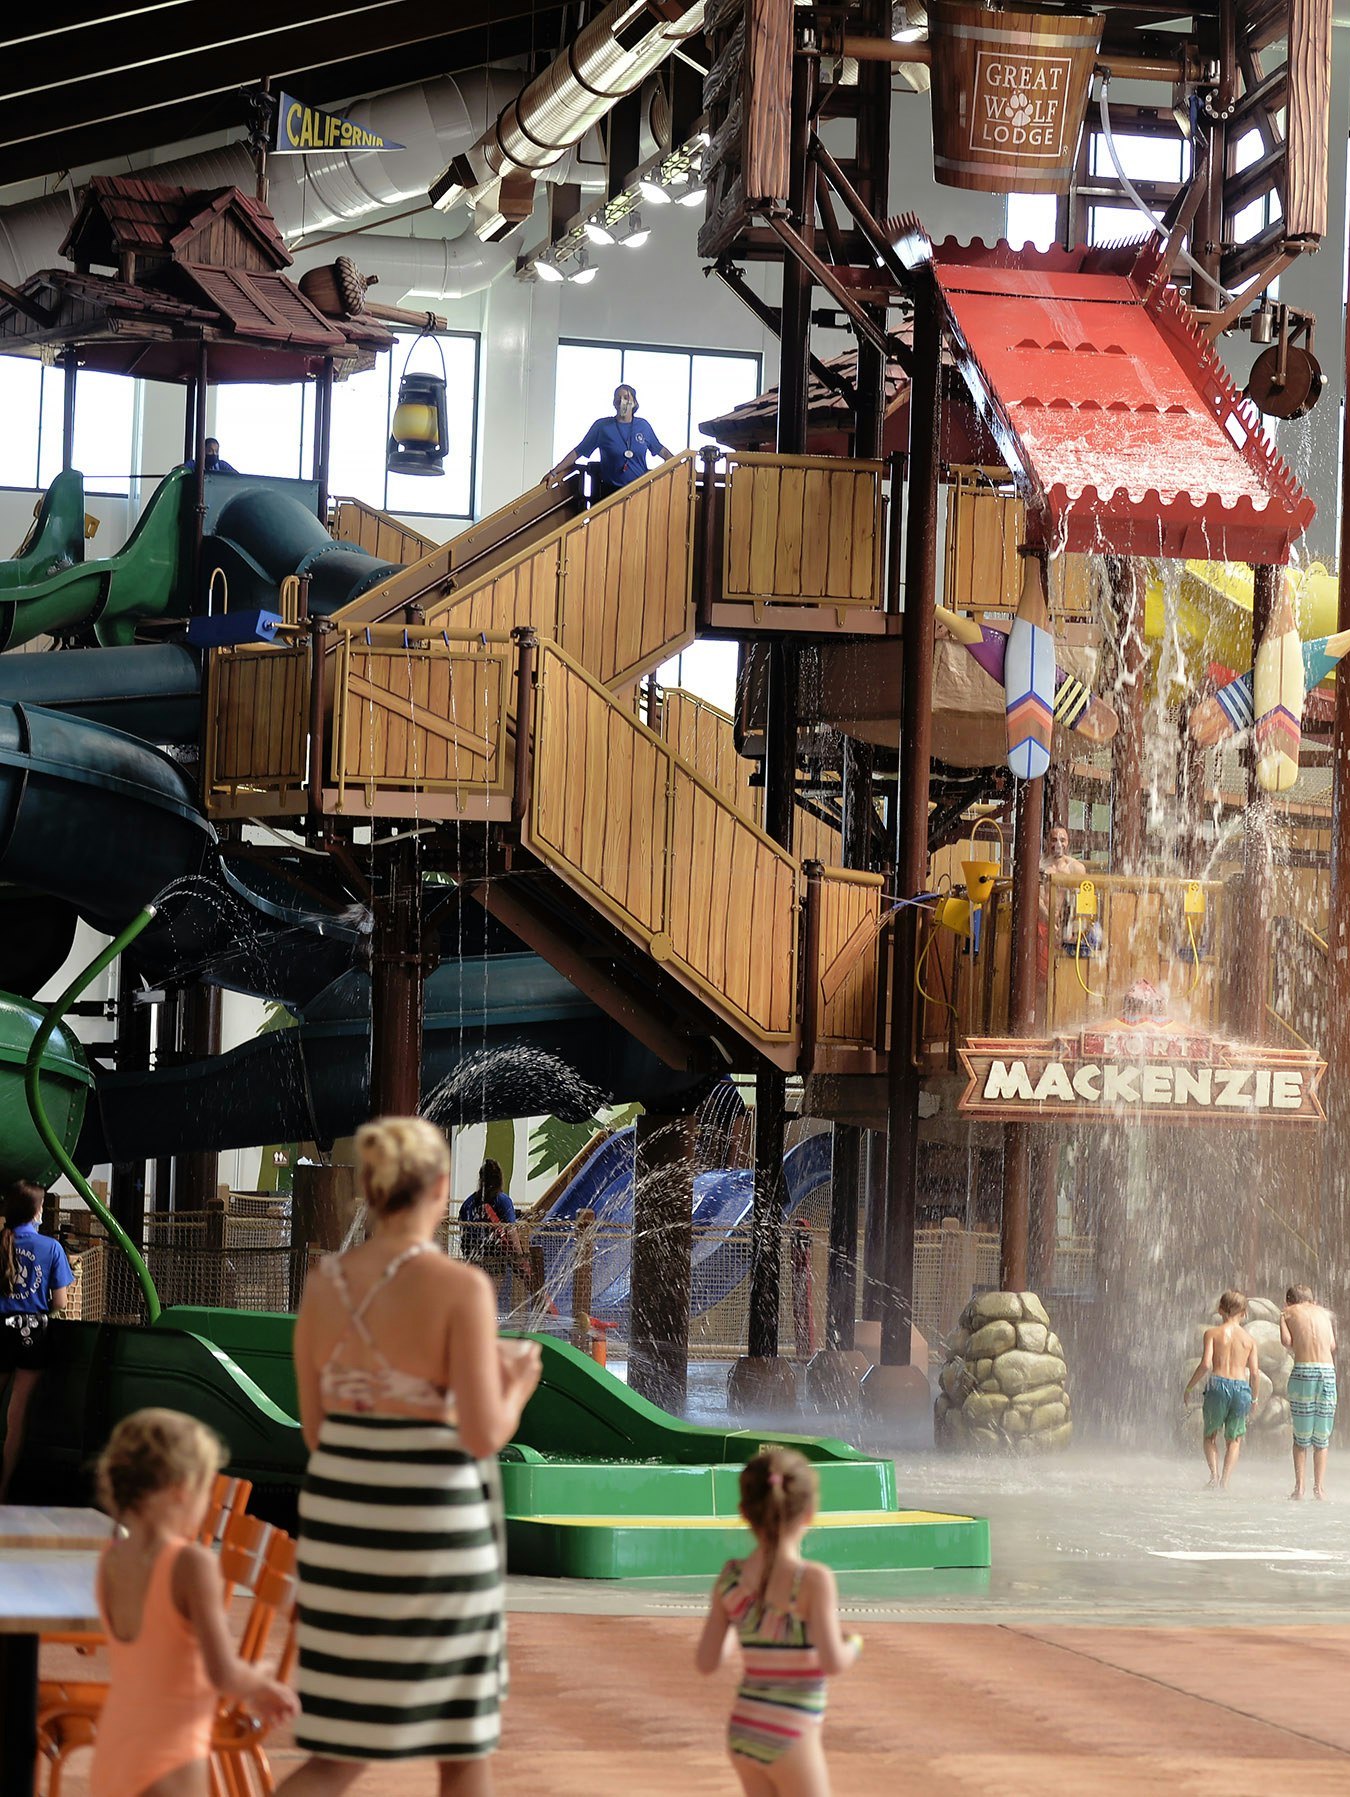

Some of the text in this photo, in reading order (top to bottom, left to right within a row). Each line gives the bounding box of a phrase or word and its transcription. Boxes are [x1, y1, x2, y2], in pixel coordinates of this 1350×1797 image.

[986, 63, 1063, 90] GREAT
[286, 102, 384, 147] CALIFORNIA
[983, 123, 1054, 145] LODGE
[1103, 1035, 1192, 1057] FORT
[983, 1060, 1303, 1109] MACKENZIE
[30, 1264, 43, 1294] LODGE
